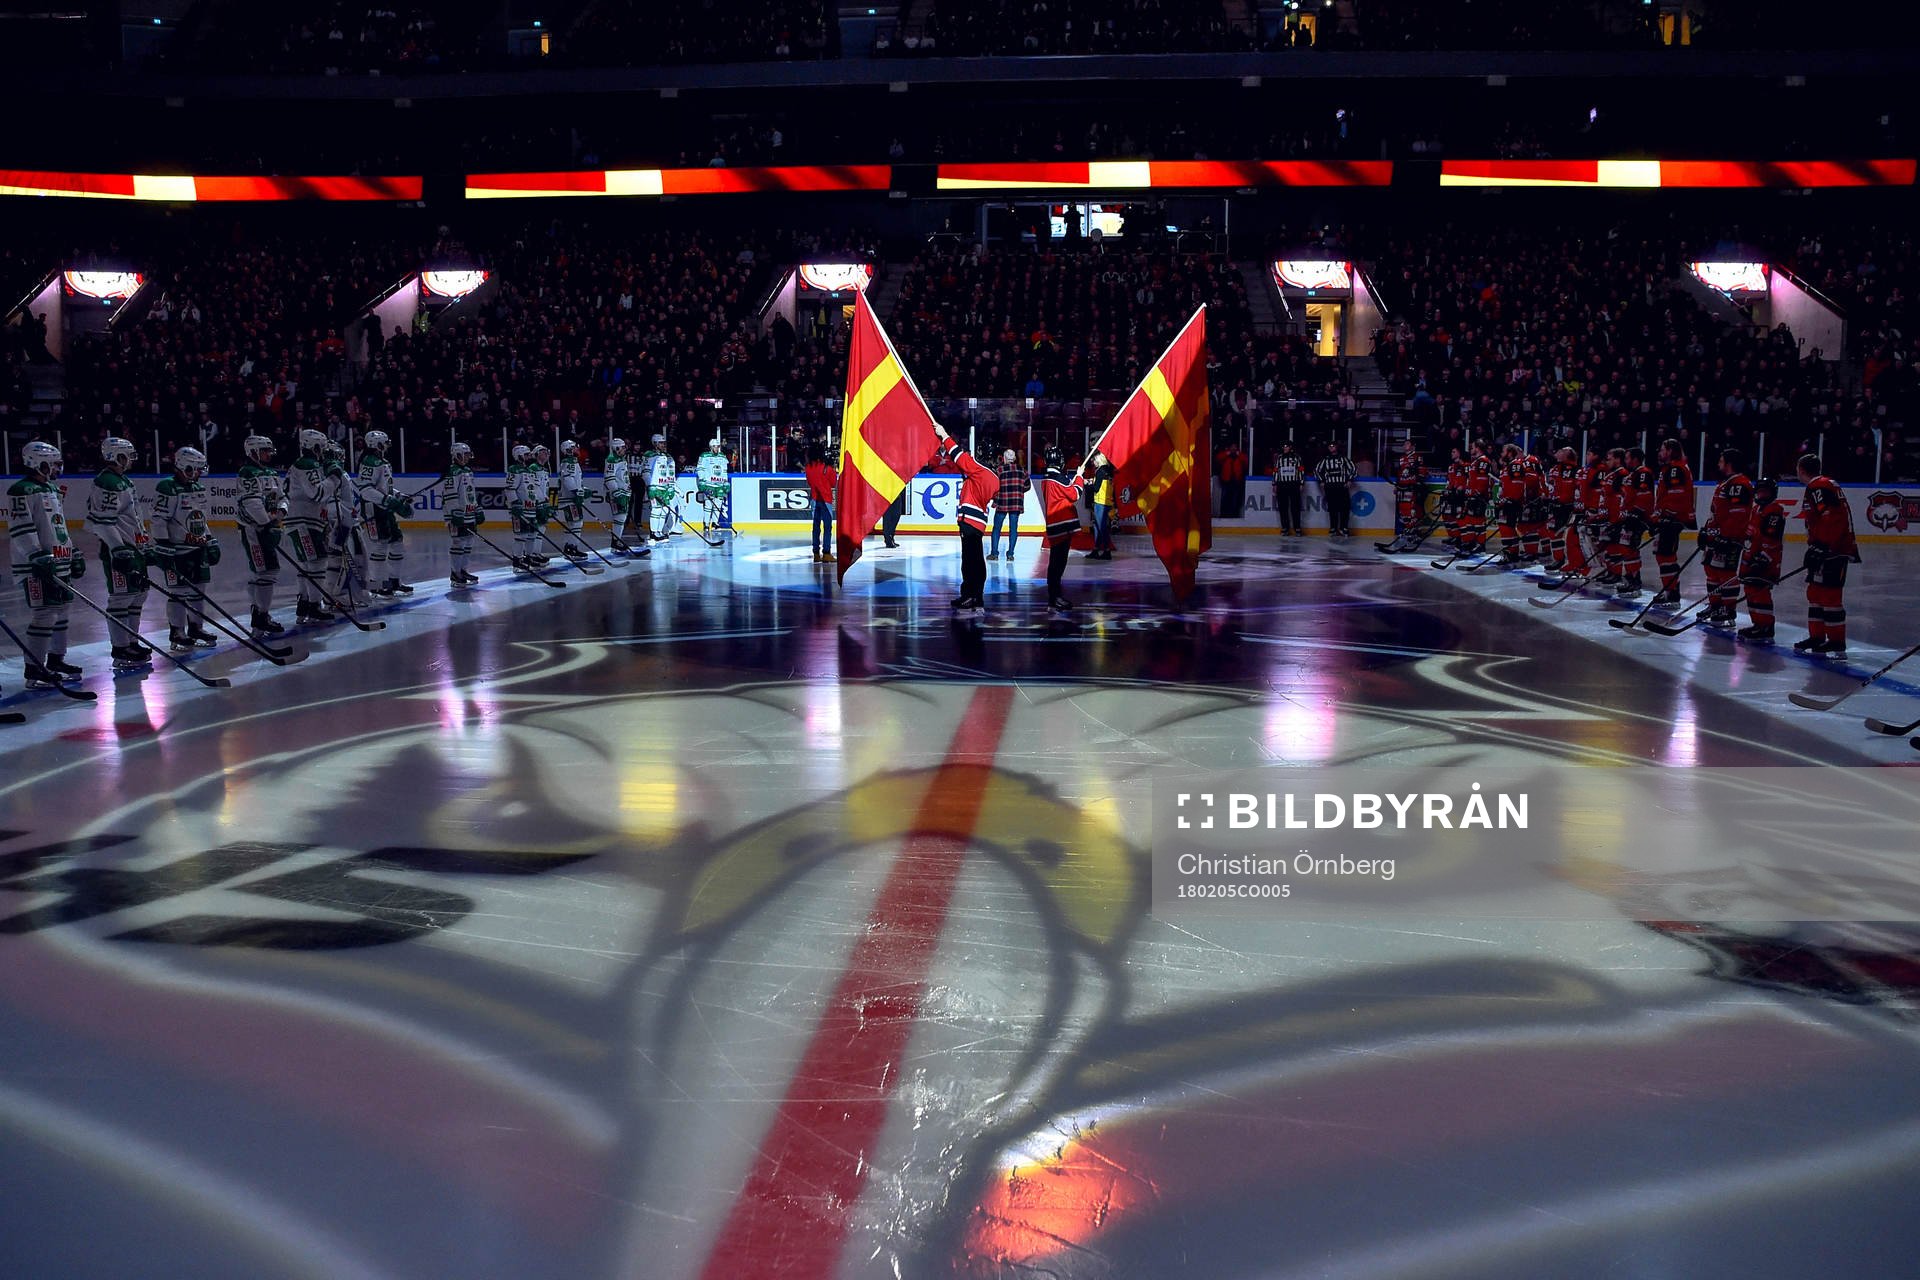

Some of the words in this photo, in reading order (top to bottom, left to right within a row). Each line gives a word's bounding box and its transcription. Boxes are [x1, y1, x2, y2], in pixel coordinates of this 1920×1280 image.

[243, 478, 258, 490] 52
[1728, 485, 1743, 497] 43
[102, 491, 118, 506] 32
[157, 493, 170, 508] 21
[1811, 488, 1824, 504] 12
[11, 497, 27, 512] 15
